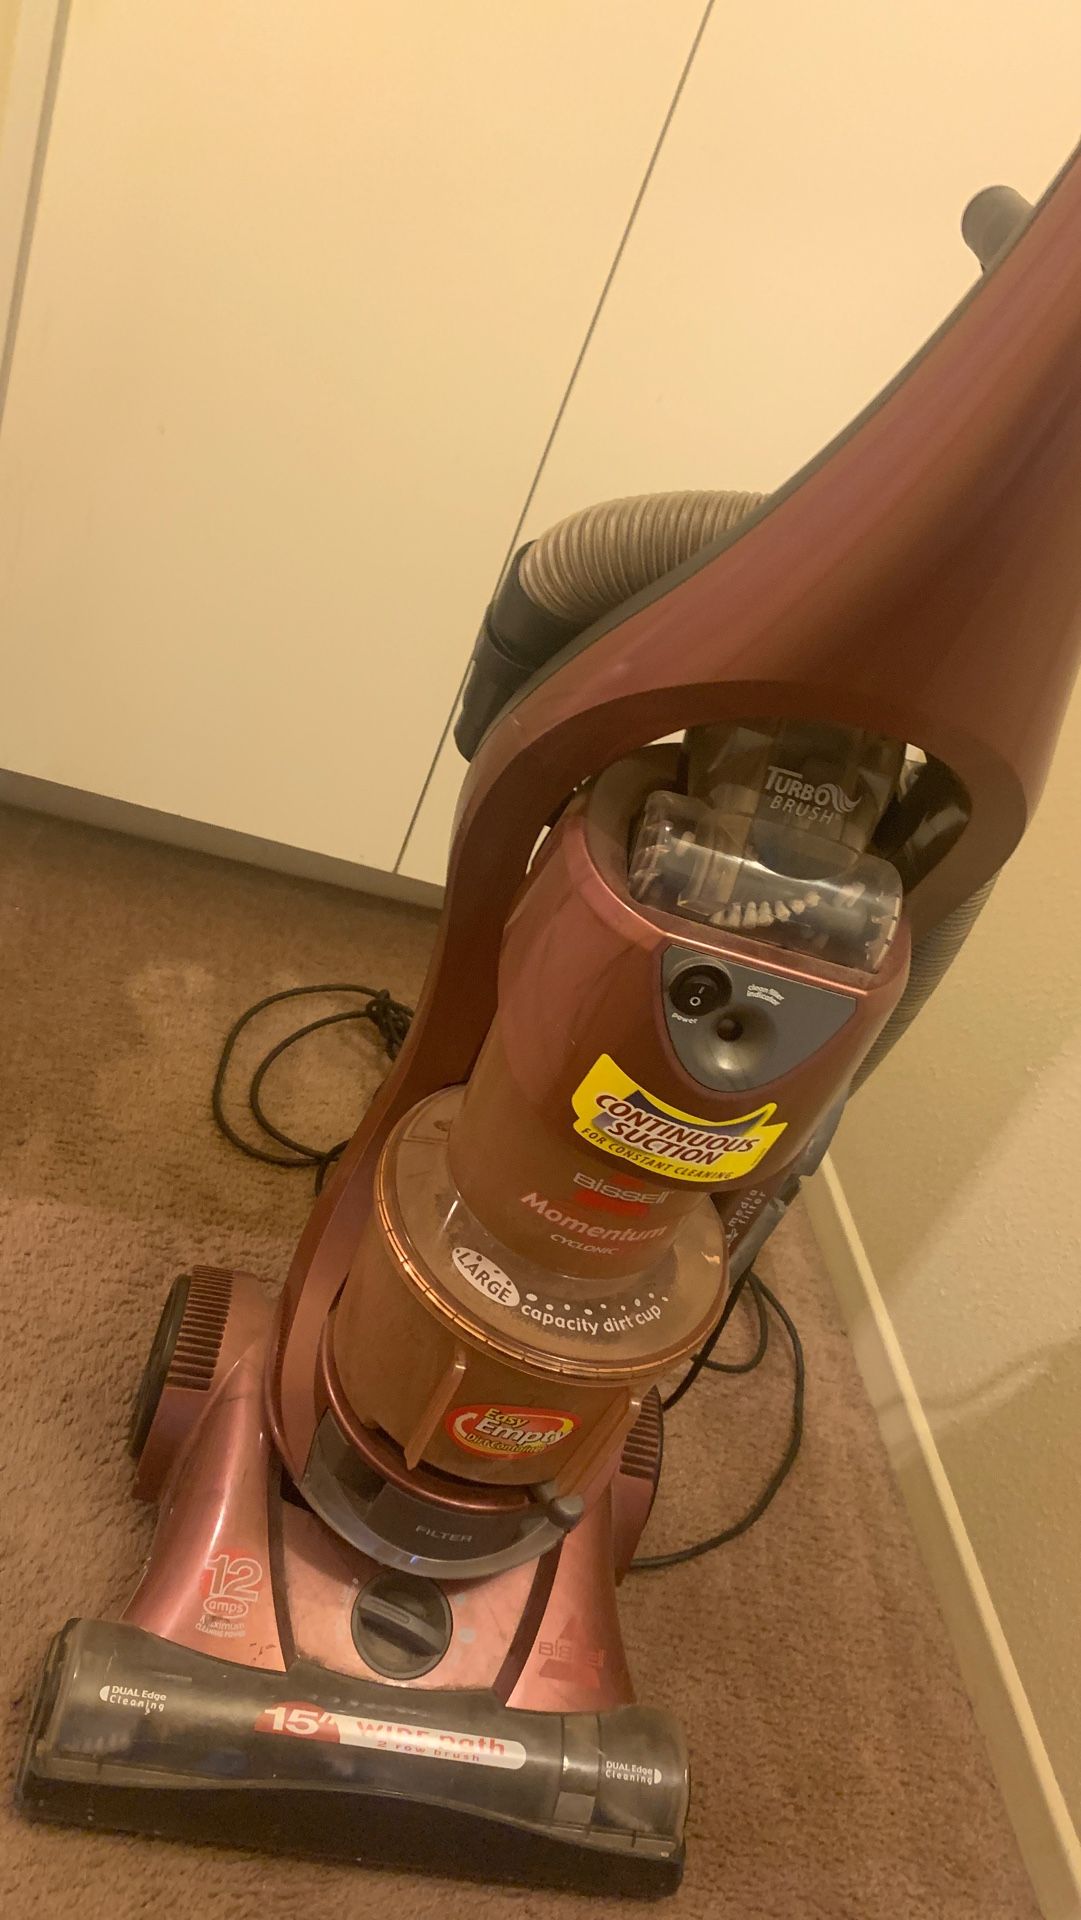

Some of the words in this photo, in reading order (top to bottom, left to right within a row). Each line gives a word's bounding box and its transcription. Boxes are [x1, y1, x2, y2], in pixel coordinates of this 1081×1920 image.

[765, 765, 833, 806] TURBO
[770, 795, 834, 824] BRUSH
[671, 1012, 698, 1024] power
[595, 1094, 760, 1152] CONTINUOUS
[582, 1127, 606, 1144] FOR
[608, 1143, 673, 1171] CONSTANT
[673, 1166, 734, 1179] CLEANING
[608, 1122, 724, 1165] SUCTION
[521, 1192, 668, 1241] Momentum
[550, 1233, 620, 1255] CYCLONIC
[457, 1252, 512, 1303] LARGE
[521, 1303, 599, 1335] capacity
[603, 1316, 634, 1333] dirt
[635, 1305, 662, 1325] cup
[484, 1408, 529, 1428] Easy
[475, 1417, 572, 1445] Empty
[416, 1525, 472, 1542] FILTER
[205, 1554, 263, 1602] 12
[209, 1599, 244, 1614] amps
[109, 1694, 165, 1712] Cleaning
[111, 1685, 140, 1698] DUAL
[141, 1690, 167, 1701] Edge
[377, 1740, 387, 1748] 2
[395, 1745, 426, 1753] row
[433, 1749, 480, 1762] brush
[605, 1769, 653, 1786] Cleaning
[606, 1760, 631, 1771] DUAL
[631, 1764, 654, 1776] Edge
